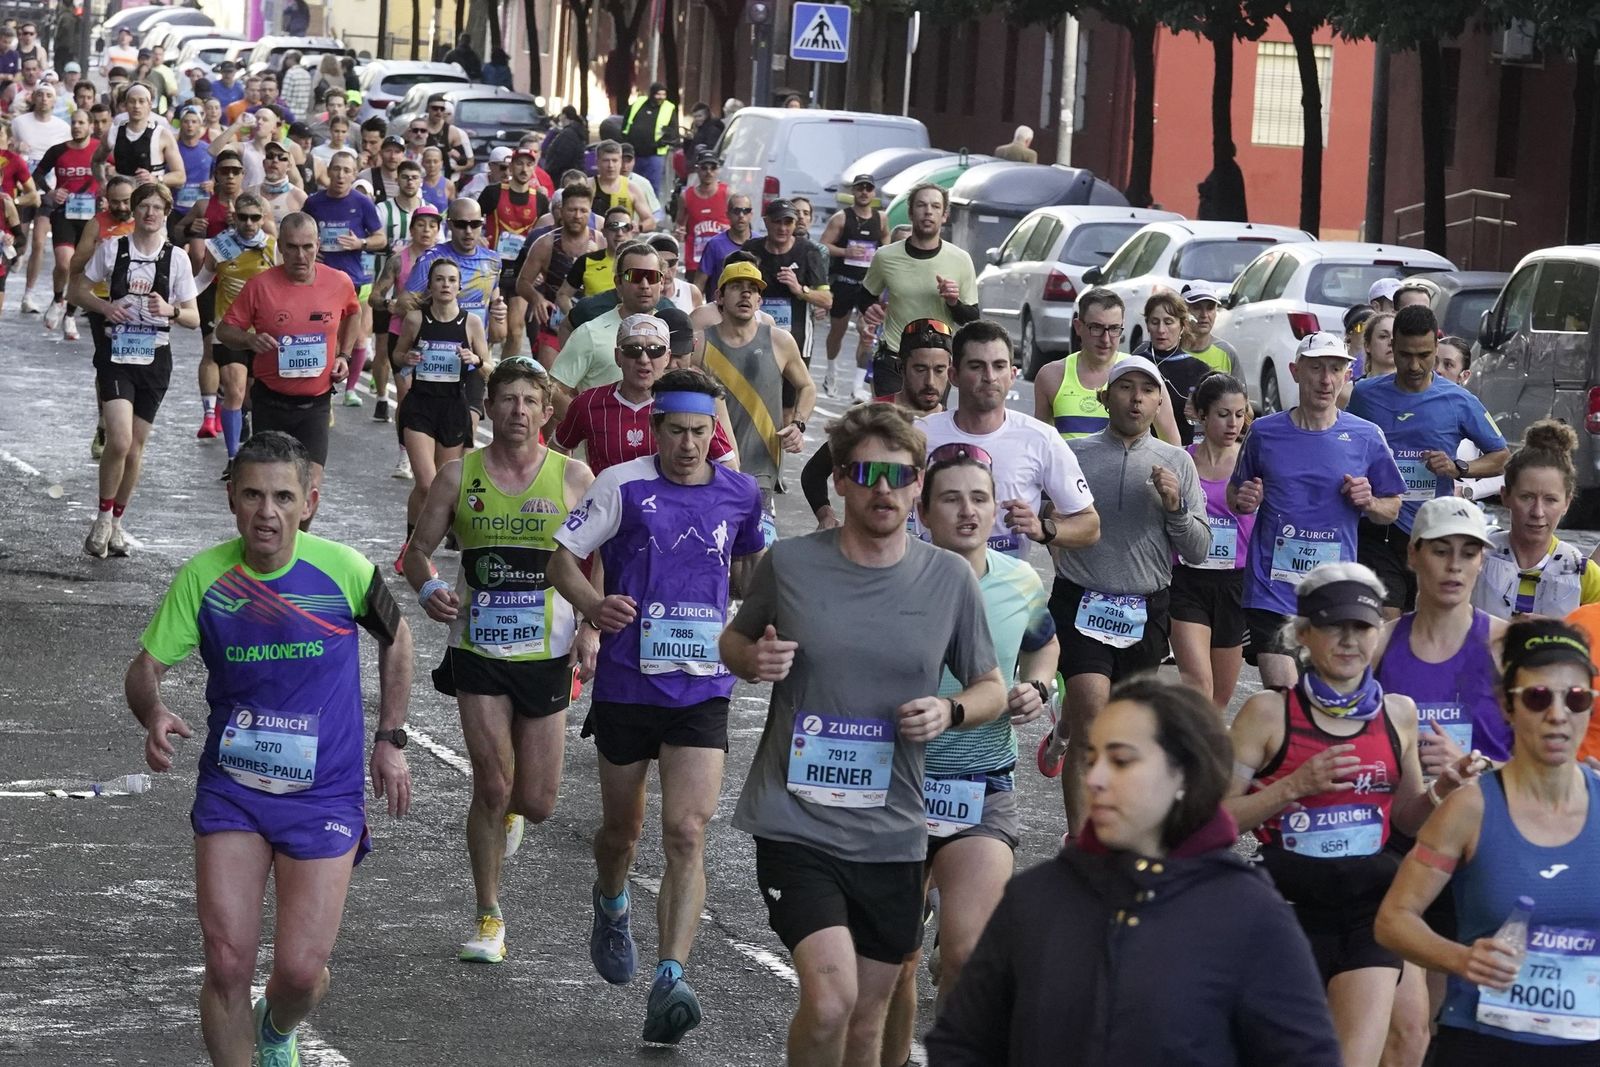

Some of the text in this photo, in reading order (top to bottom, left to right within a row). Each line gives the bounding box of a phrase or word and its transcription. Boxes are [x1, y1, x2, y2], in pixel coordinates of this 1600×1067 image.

[112, 346, 155, 356] ALEXANDRE
[288, 357, 319, 368] DIDIER
[422, 362, 454, 373] SOPHIE
[1397, 450, 1425, 459] ZURIC
[1404, 479, 1437, 489] EDDINE
[471, 513, 547, 536] melgar
[1207, 517, 1231, 527] RICH
[1299, 529, 1336, 540] ZURICH
[986, 538, 1011, 550] RICH
[1208, 545, 1229, 557] LES
[1298, 546, 1318, 557] 7427
[489, 570, 545, 580] station
[494, 595, 536, 605] ZURICH
[670, 606, 714, 618] ZURICH
[1105, 606, 1125, 619] 7318
[495, 615, 518, 625] 7063
[1087, 614, 1134, 634] ROCHDI
[475, 625, 540, 642] PEPE REY
[670, 628, 694, 639] 7885
[652, 641, 708, 659] MIQUEL
[1416, 708, 1461, 721] URICH
[255, 715, 309, 731] ZURICH
[828, 721, 884, 737] ZURICH
[254, 740, 283, 755] 7970
[828, 748, 858, 762] 7912
[219, 753, 314, 781] ANDRES-PAULA
[806, 763, 873, 786] RIENER
[924, 780, 952, 795] 8479
[924, 797, 969, 819] NOLD
[1316, 808, 1373, 826] ZURICH
[1321, 839, 1350, 853] 8561
[1531, 931, 1598, 951] ZURICH
[1529, 964, 1562, 981] 7721
